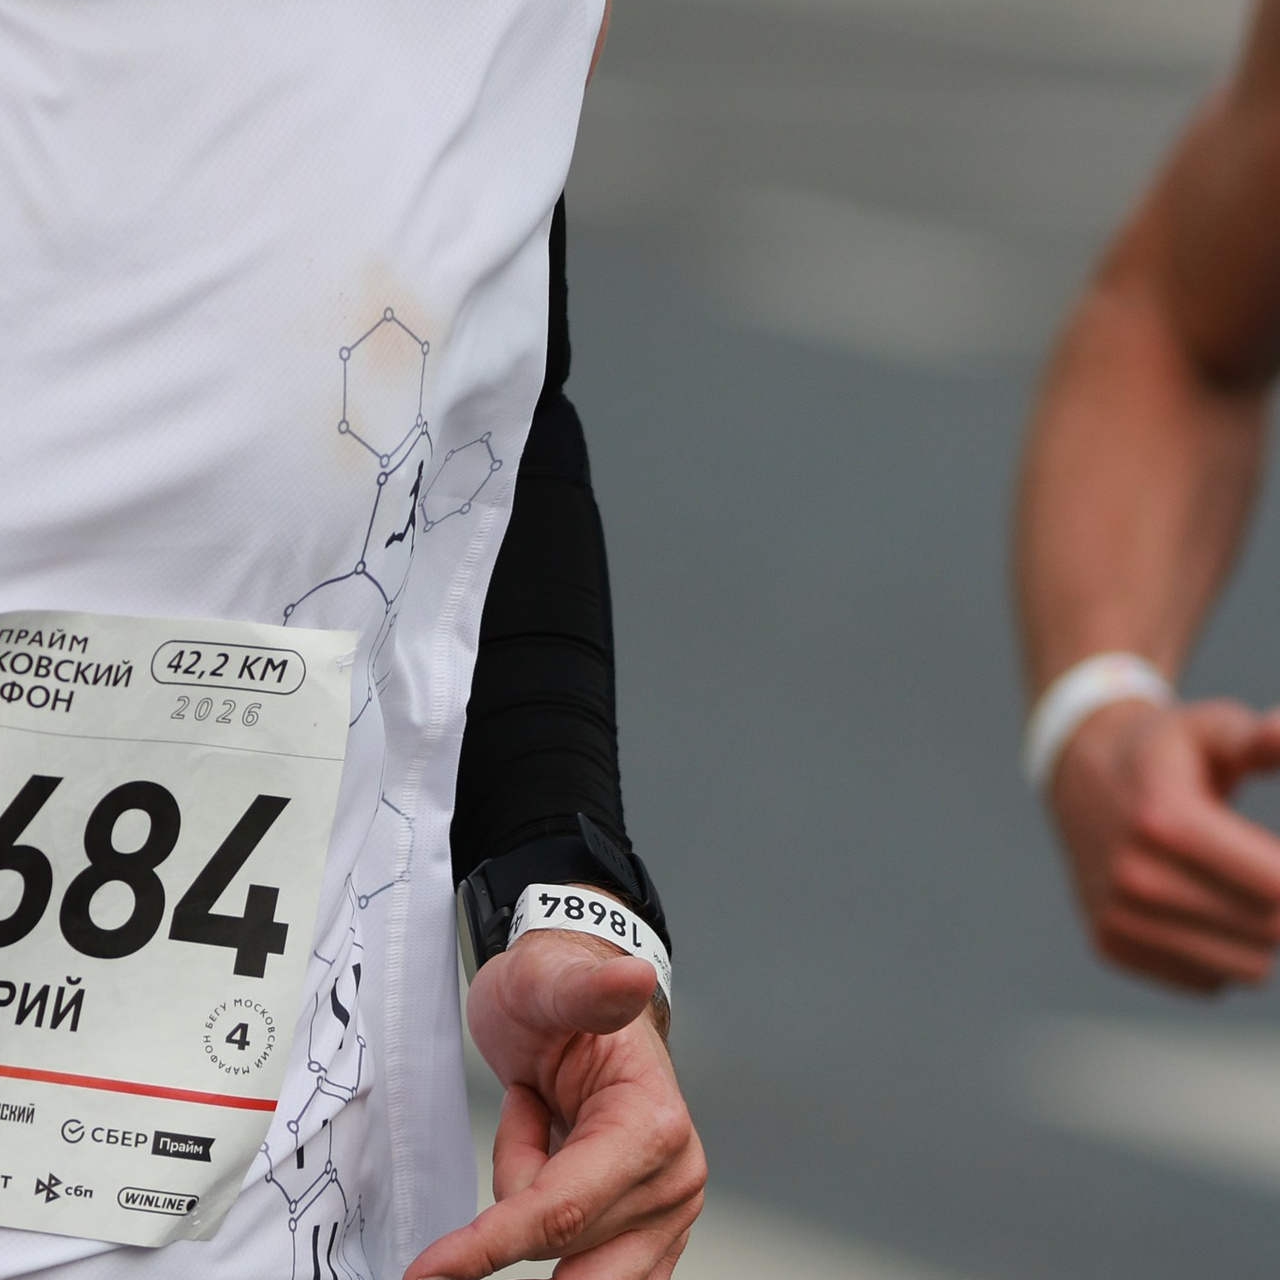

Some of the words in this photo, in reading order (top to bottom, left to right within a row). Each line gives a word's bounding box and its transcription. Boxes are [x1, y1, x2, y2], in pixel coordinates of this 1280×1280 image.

[166, 649, 230, 680] 42,2
[237, 655, 289, 684] КМ
[170, 695, 263, 727] 2026
[538, 892, 642, 948] 18684
[205, 1002, 227, 1030] БЕГУ
[225, 1022, 251, 1051] 4
[233, 998, 276, 1069] МОСКОВСКИЙ
[203, 1034, 251, 1076] МАРАФОН
[91, 1126, 148, 1148] СБЕР
[158, 1137, 204, 1155] Прайм
[64, 1184, 94, 1199] сбп
[124, 1191, 186, 1211] WINLINE
